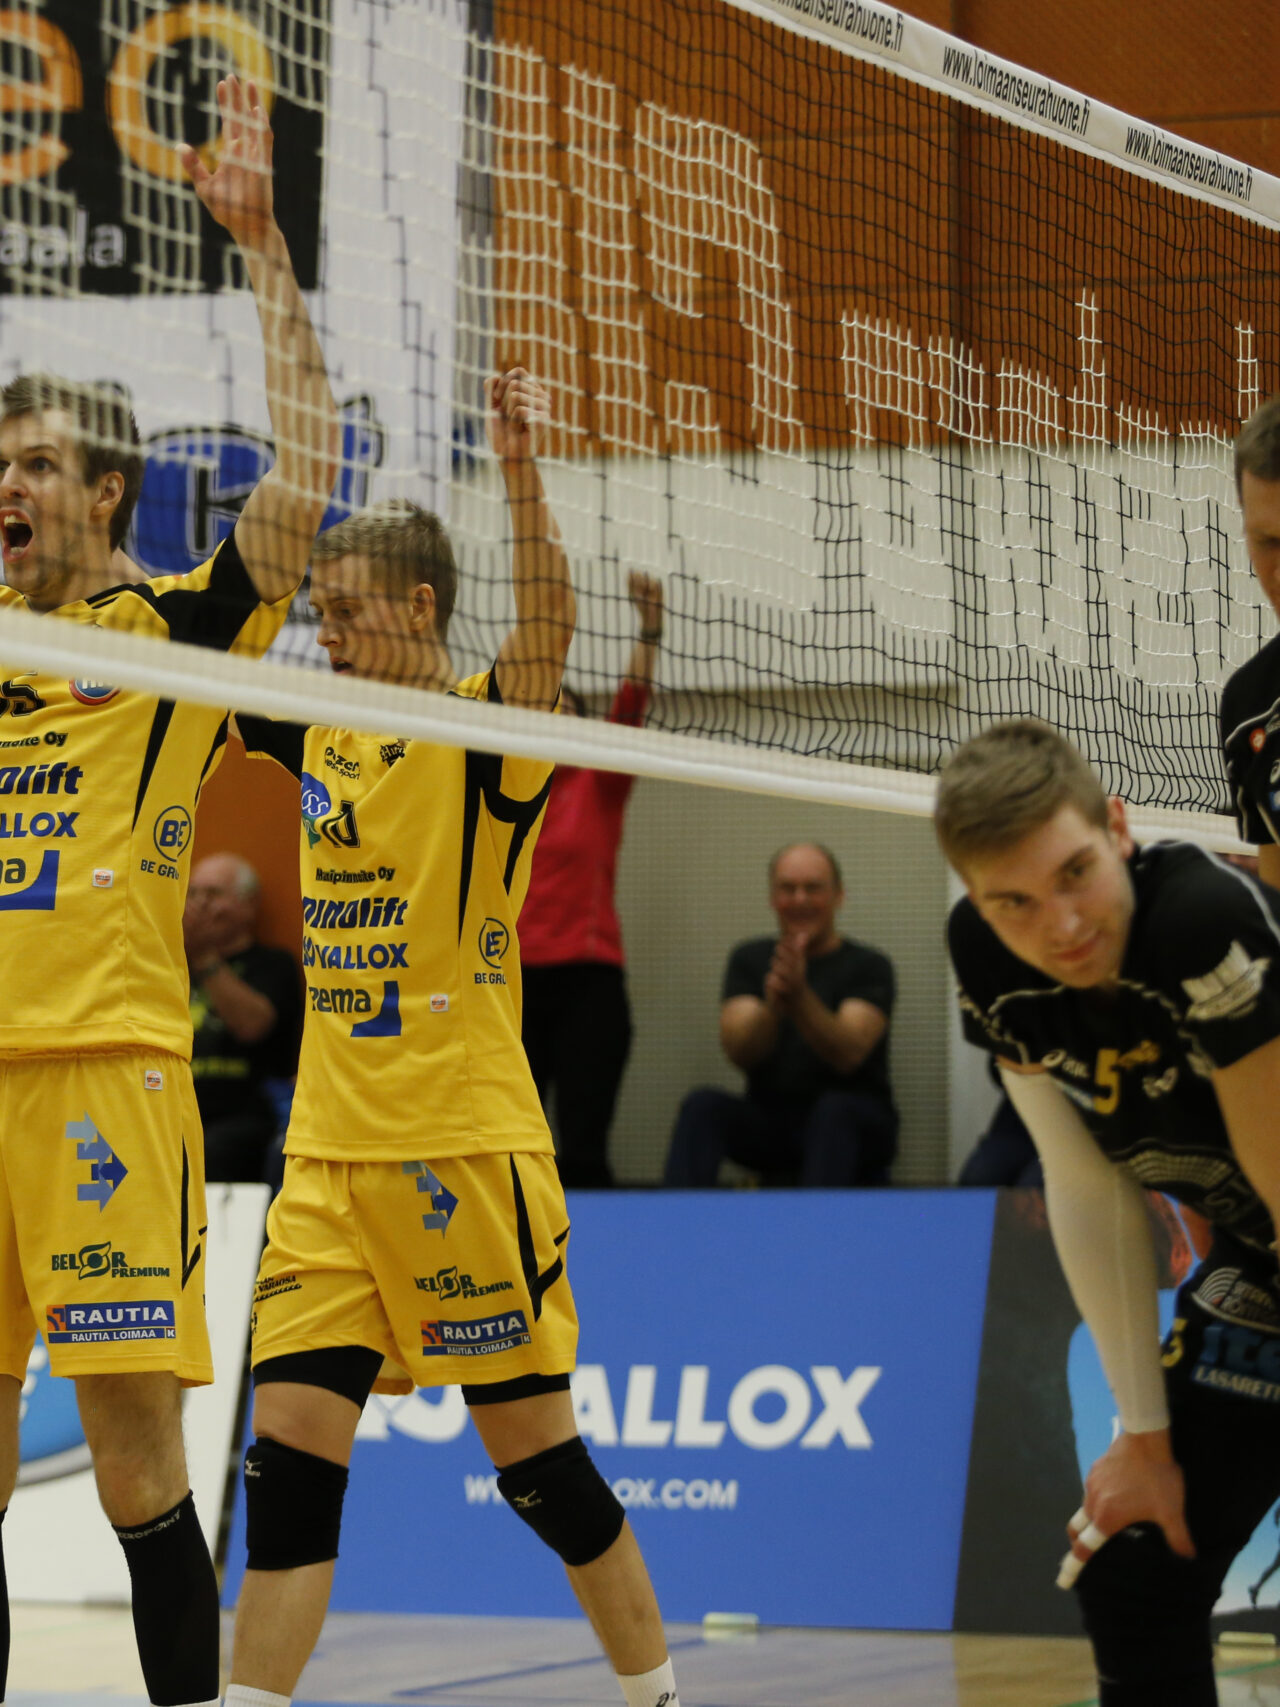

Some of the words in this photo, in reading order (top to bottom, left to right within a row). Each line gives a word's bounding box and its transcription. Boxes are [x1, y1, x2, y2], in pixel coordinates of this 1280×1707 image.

[942, 43, 1091, 136] www.loimaanseurahuone.fi
[1125, 124, 1254, 202] www.loimaanseurahuone.fi
[44, 731, 69, 748] Oy
[140, 858, 156, 874] BE
[377, 865, 396, 882] Oy
[474, 972, 488, 984] BE
[1093, 1047, 1120, 1115] 5
[111, 1266, 170, 1279] PREMIUM
[463, 1280, 514, 1299] PREMIUM
[70, 1306, 169, 1325] RAUTIA
[71, 1331, 110, 1342] RAUTIA
[112, 1329, 157, 1340] LOIMAA
[443, 1316, 523, 1340] RAUTIA
[474, 1340, 515, 1354] LOIMAA
[570, 1364, 883, 1451] ALLOX
